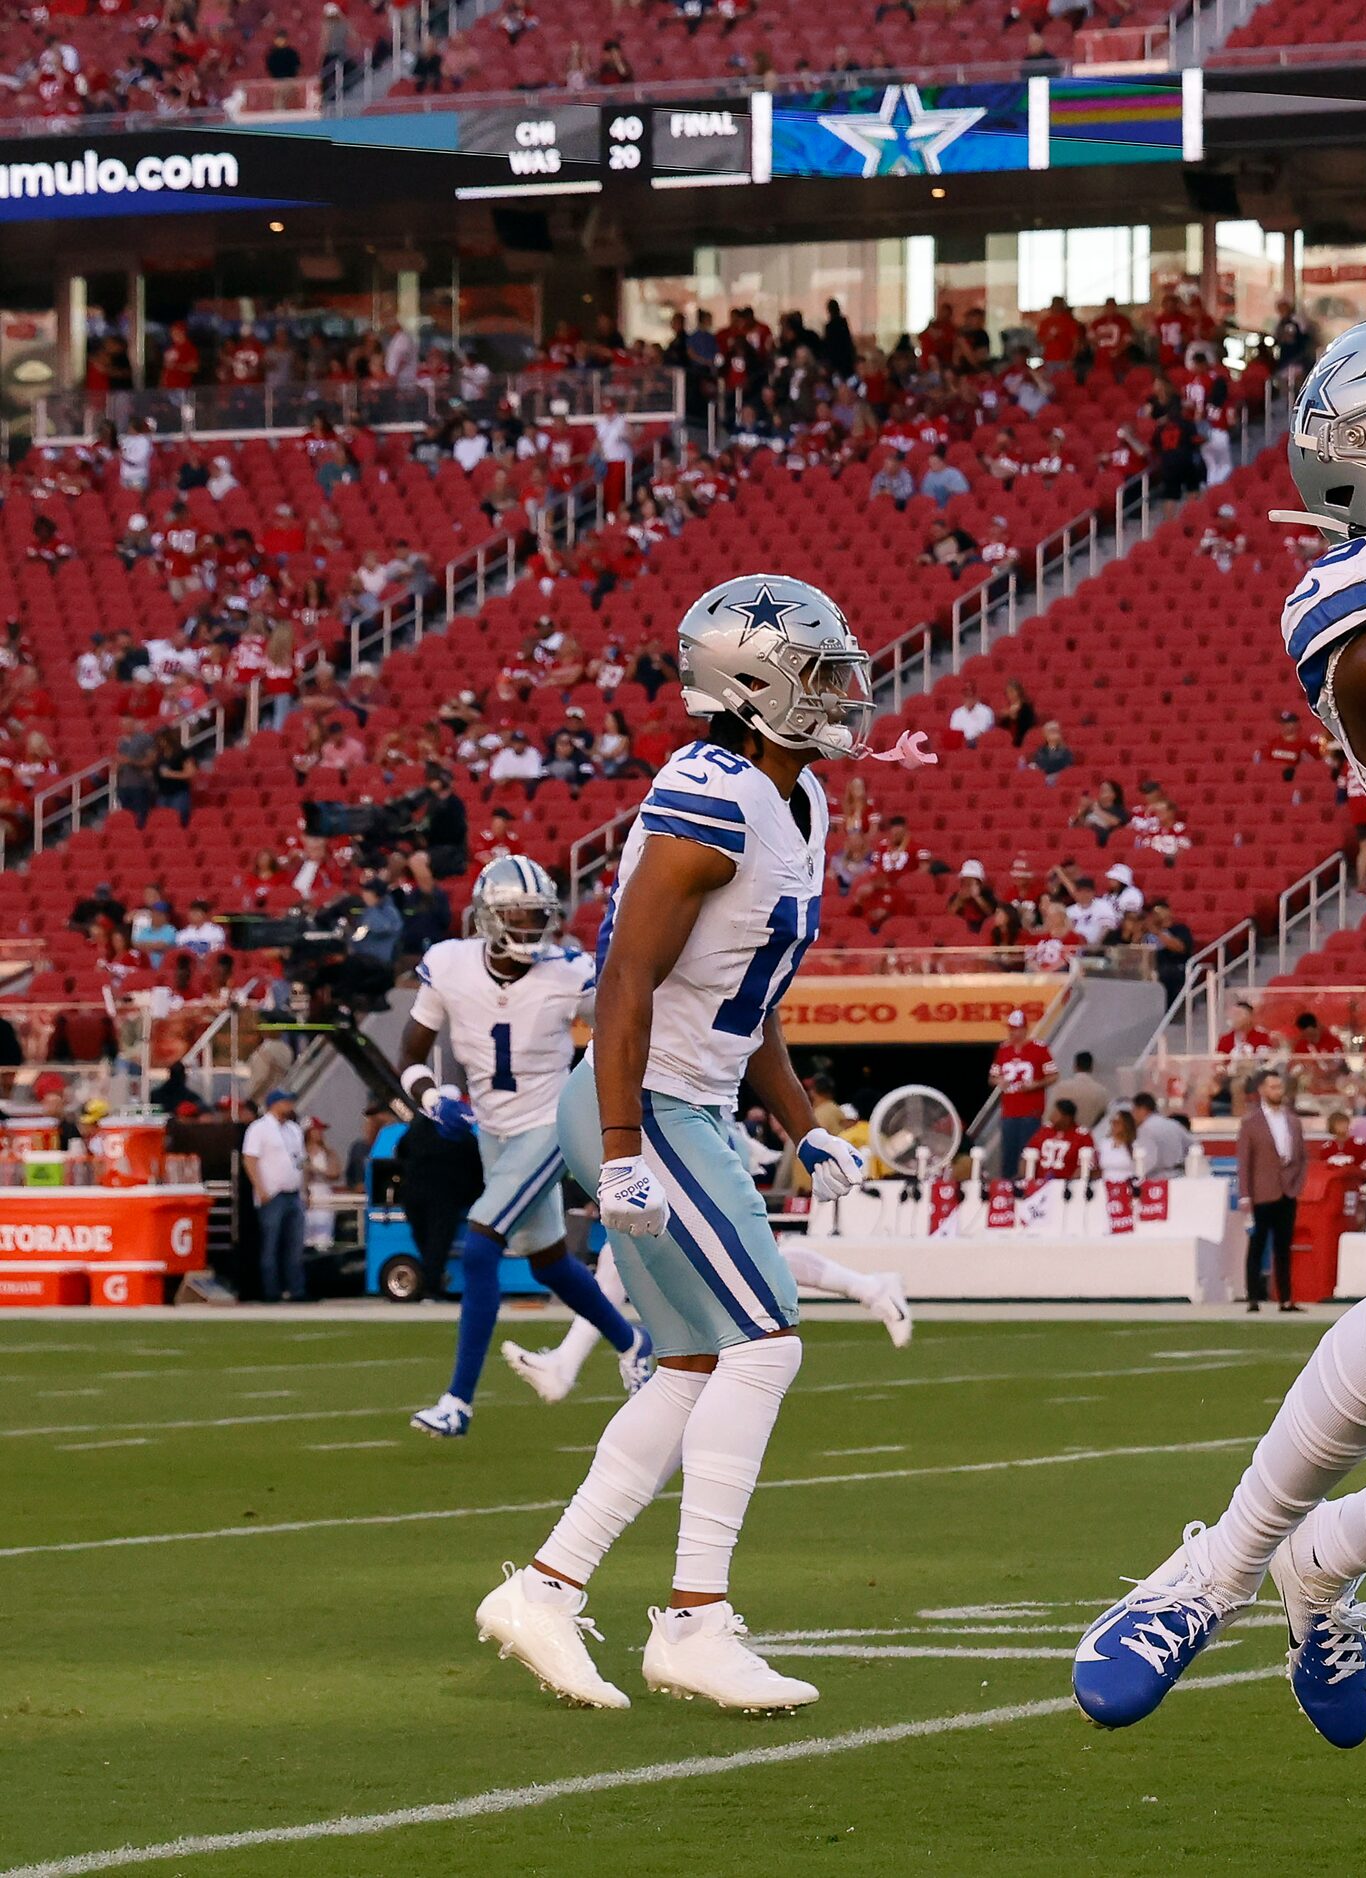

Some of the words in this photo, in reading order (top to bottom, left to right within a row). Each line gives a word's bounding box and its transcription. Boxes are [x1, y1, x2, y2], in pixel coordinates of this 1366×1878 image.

[515, 120, 556, 147] CHI
[609, 115, 644, 141] 40
[670, 111, 738, 138] FINAL
[508, 149, 561, 175] WAS
[609, 144, 641, 170] 20
[490, 1023, 517, 1092] 1
[1040, 1139, 1071, 1169] 97
[614, 1177, 649, 1201] adidas
[0, 1224, 113, 1252] TORADE
[171, 1217, 193, 1257] G
[103, 1274, 129, 1303] G
